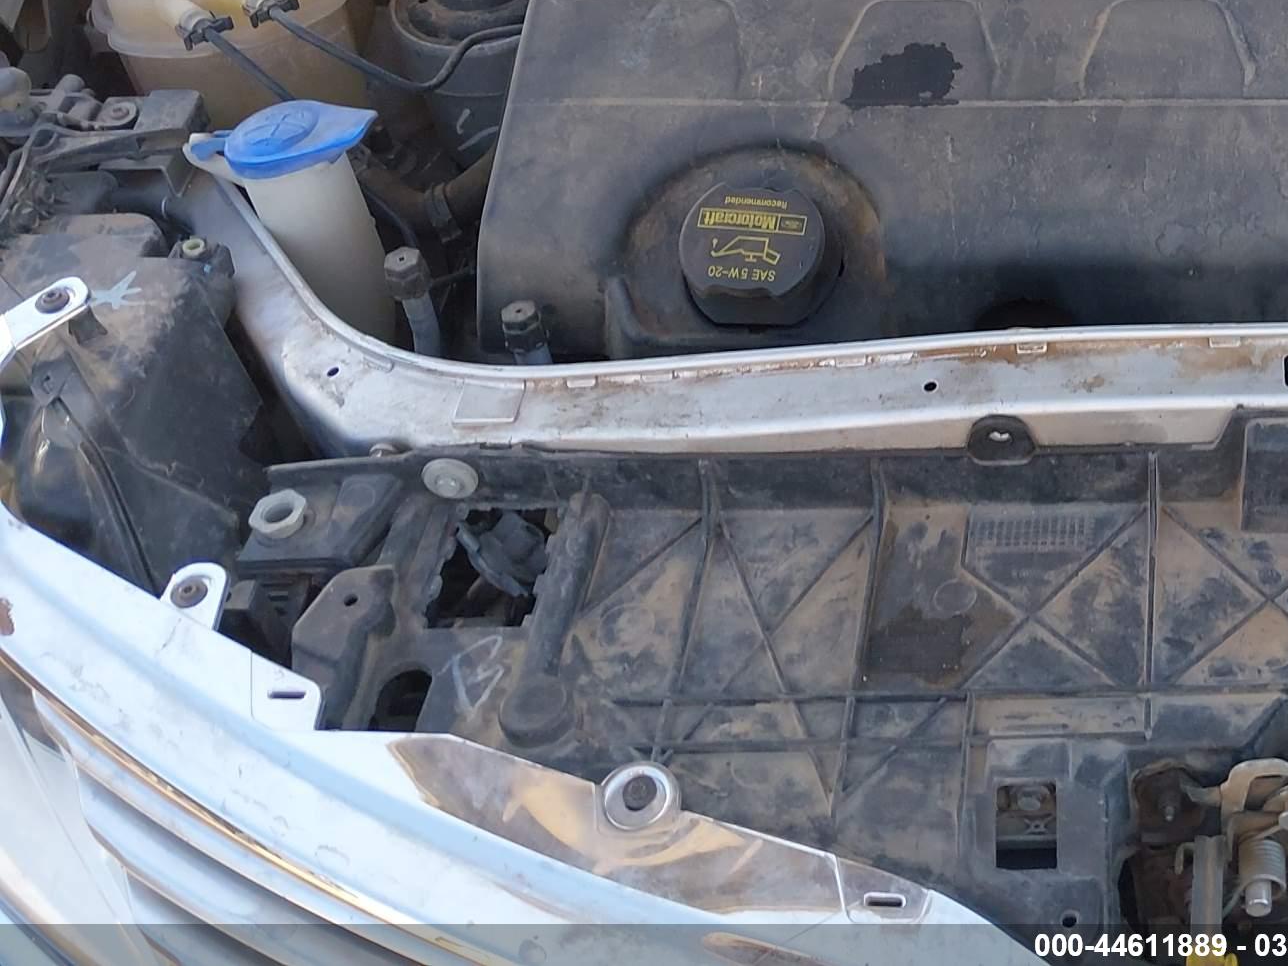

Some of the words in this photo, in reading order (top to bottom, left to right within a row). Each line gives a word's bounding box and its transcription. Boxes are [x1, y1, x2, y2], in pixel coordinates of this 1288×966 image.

[725, 195, 788, 210] Recommended
[703, 211, 777, 230] Motorcraft
[751, 268, 776, 282] SAE
